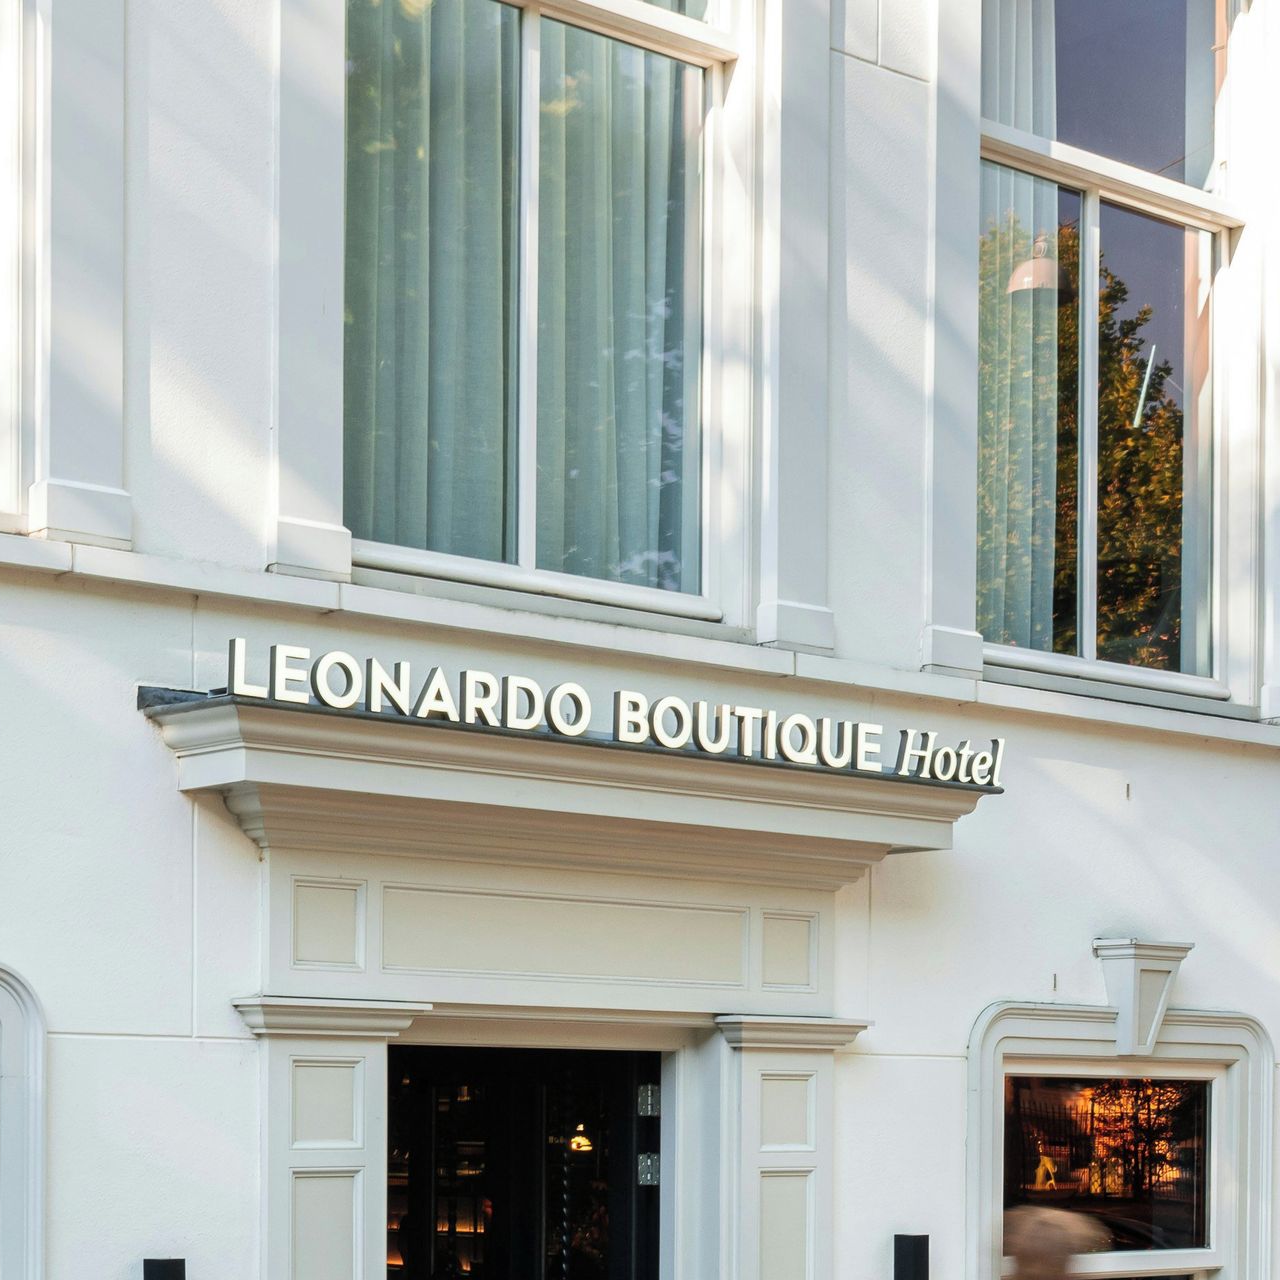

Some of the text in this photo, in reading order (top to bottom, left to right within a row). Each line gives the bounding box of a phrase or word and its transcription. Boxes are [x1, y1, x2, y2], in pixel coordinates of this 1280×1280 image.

[228, 637, 1006, 787] LEONARDO BOUTIQUE Hotel
